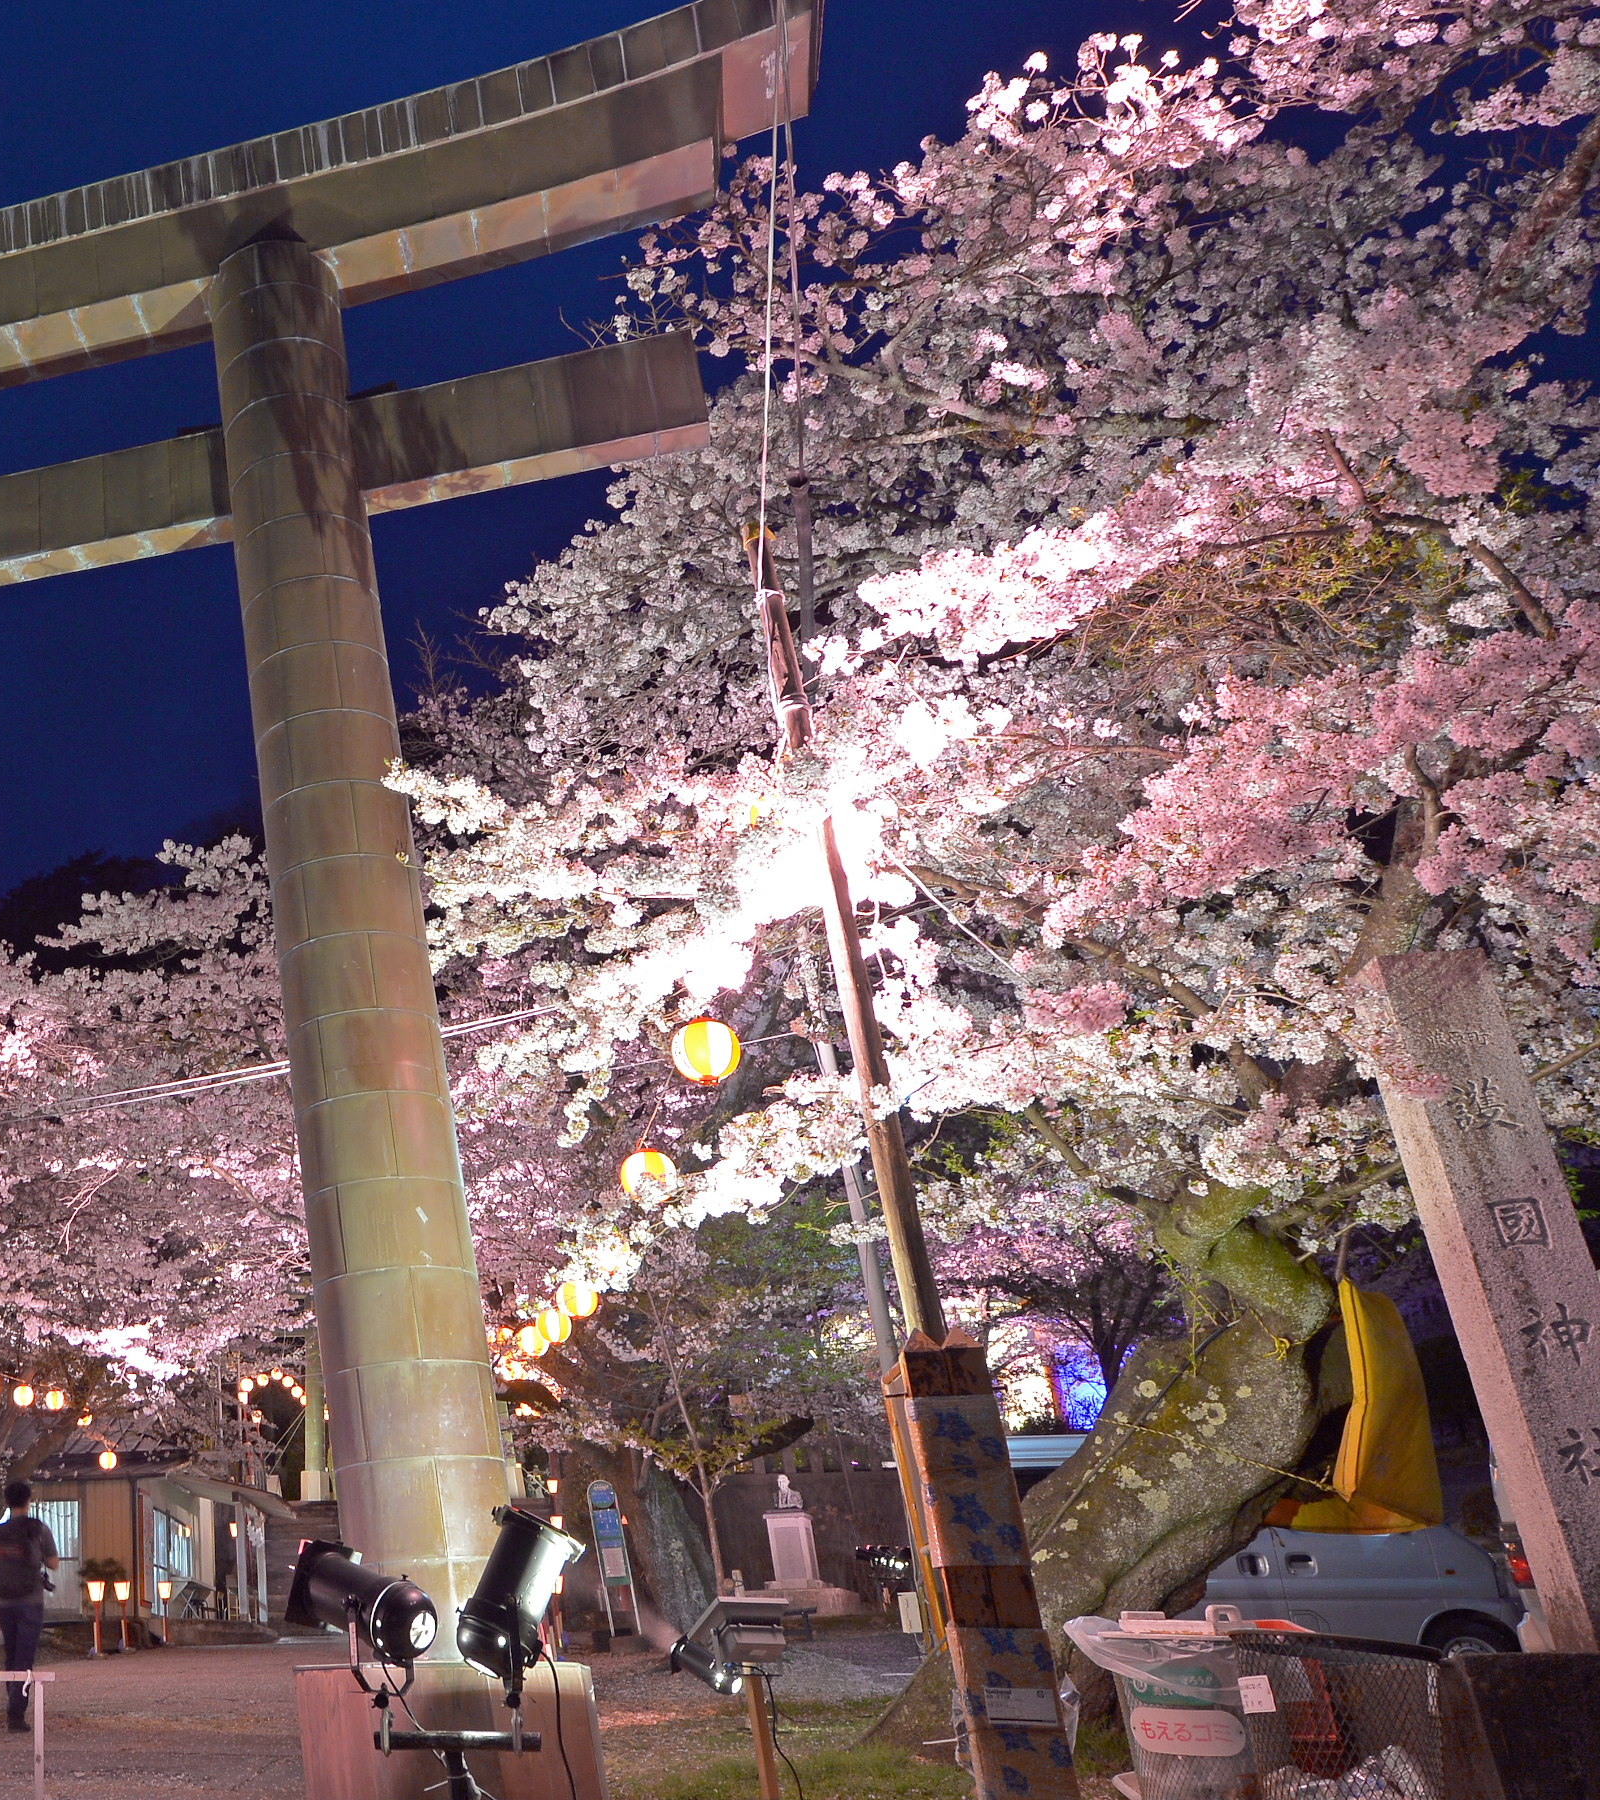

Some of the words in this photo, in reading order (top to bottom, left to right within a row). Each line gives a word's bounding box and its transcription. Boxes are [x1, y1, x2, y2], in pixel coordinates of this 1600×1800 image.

[1140, 1719, 1234, 1743] もえるゴミ
